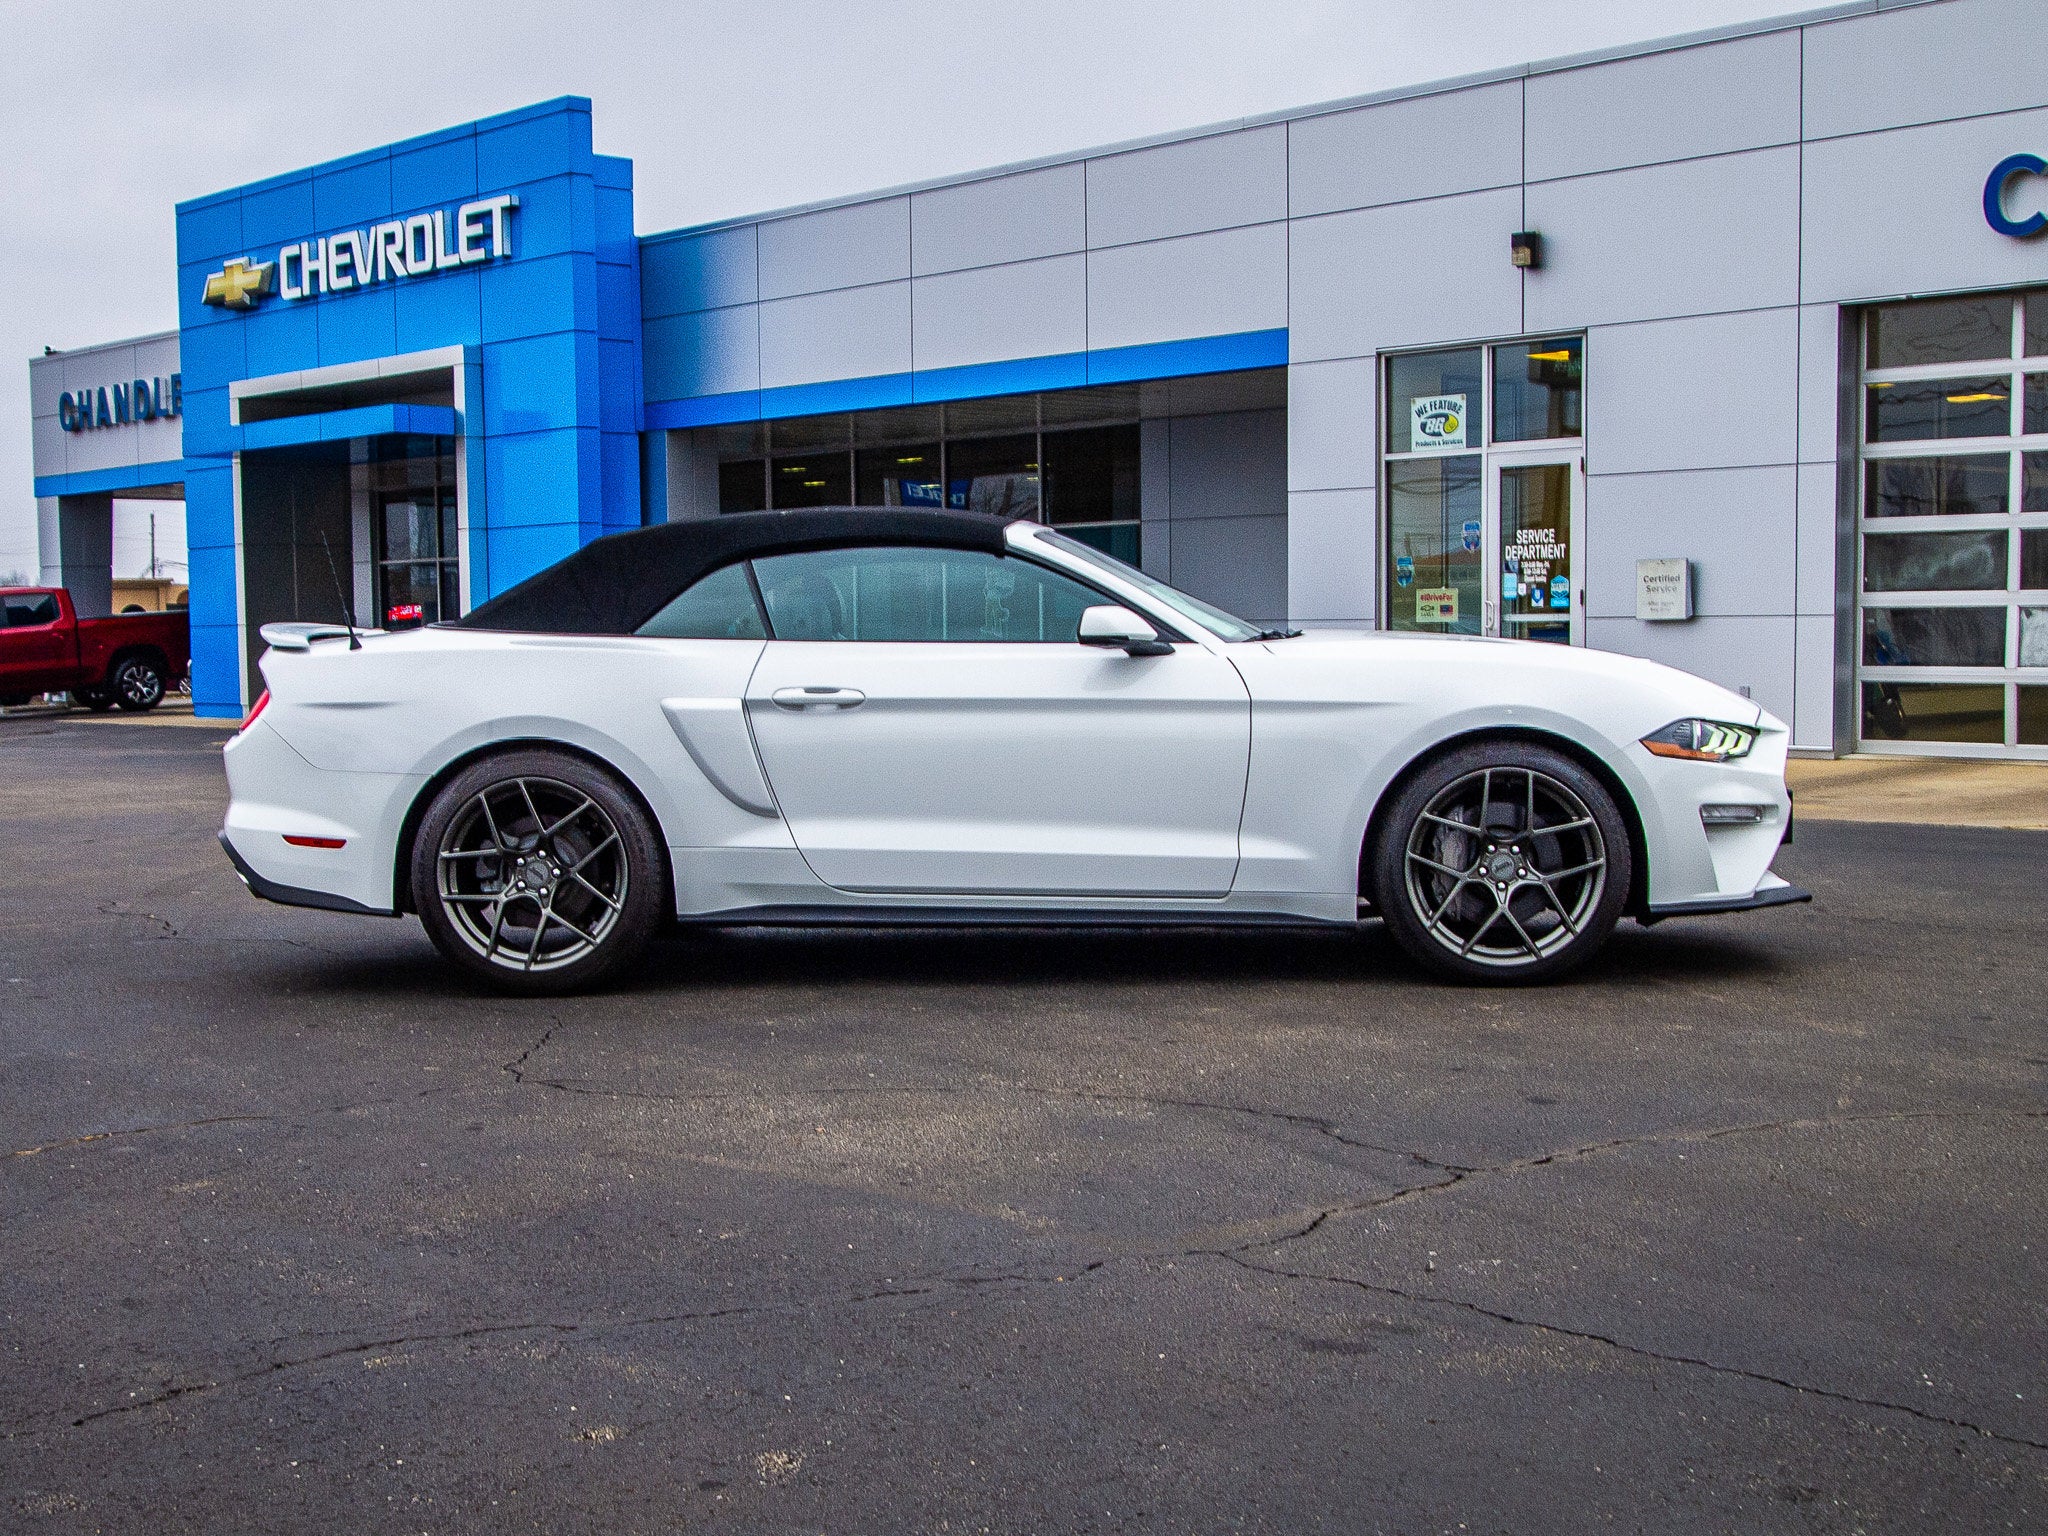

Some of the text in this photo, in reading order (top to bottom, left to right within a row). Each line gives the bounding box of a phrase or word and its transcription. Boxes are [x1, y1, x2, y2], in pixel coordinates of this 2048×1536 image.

[280, 194, 516, 300] CHEVROLET
[1415, 400, 1463, 418] WE FEATURE
[1516, 528, 1555, 544] SERVICE
[1505, 543, 1566, 560] DEPARTMENT
[1643, 574, 1681, 583] Certified
[1646, 585, 1677, 594] Service
